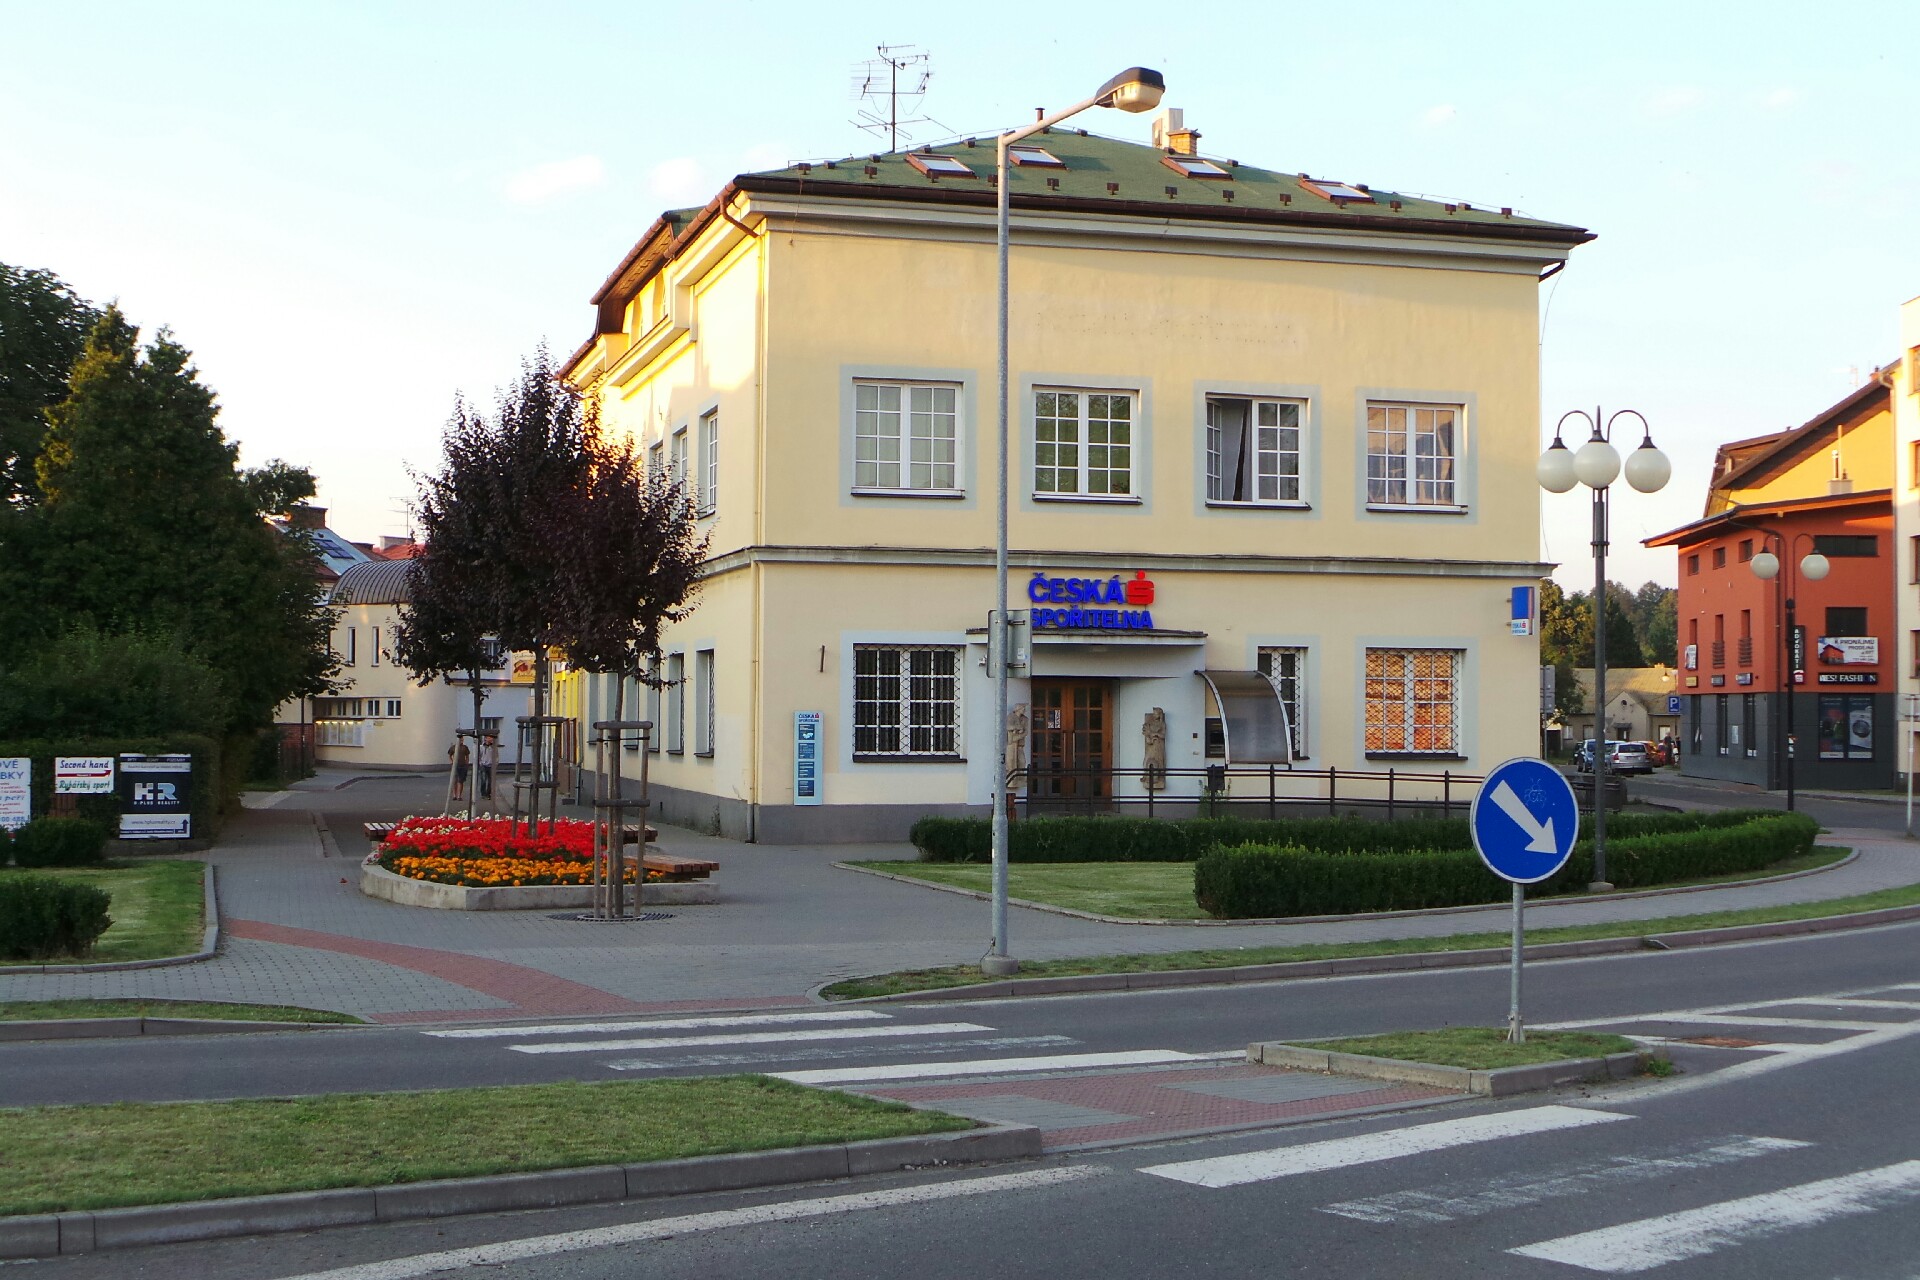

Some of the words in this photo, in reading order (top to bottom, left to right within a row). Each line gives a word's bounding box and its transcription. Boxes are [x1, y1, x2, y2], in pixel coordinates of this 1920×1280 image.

[1028, 572, 1125, 604] ČESKÁ
[1031, 604, 1154, 629] SPOŘITELNA
[1670, 698, 1677, 707] P
[60, 760, 87, 769] Second
[89, 760, 110, 769] hand
[93, 781, 110, 791] sport
